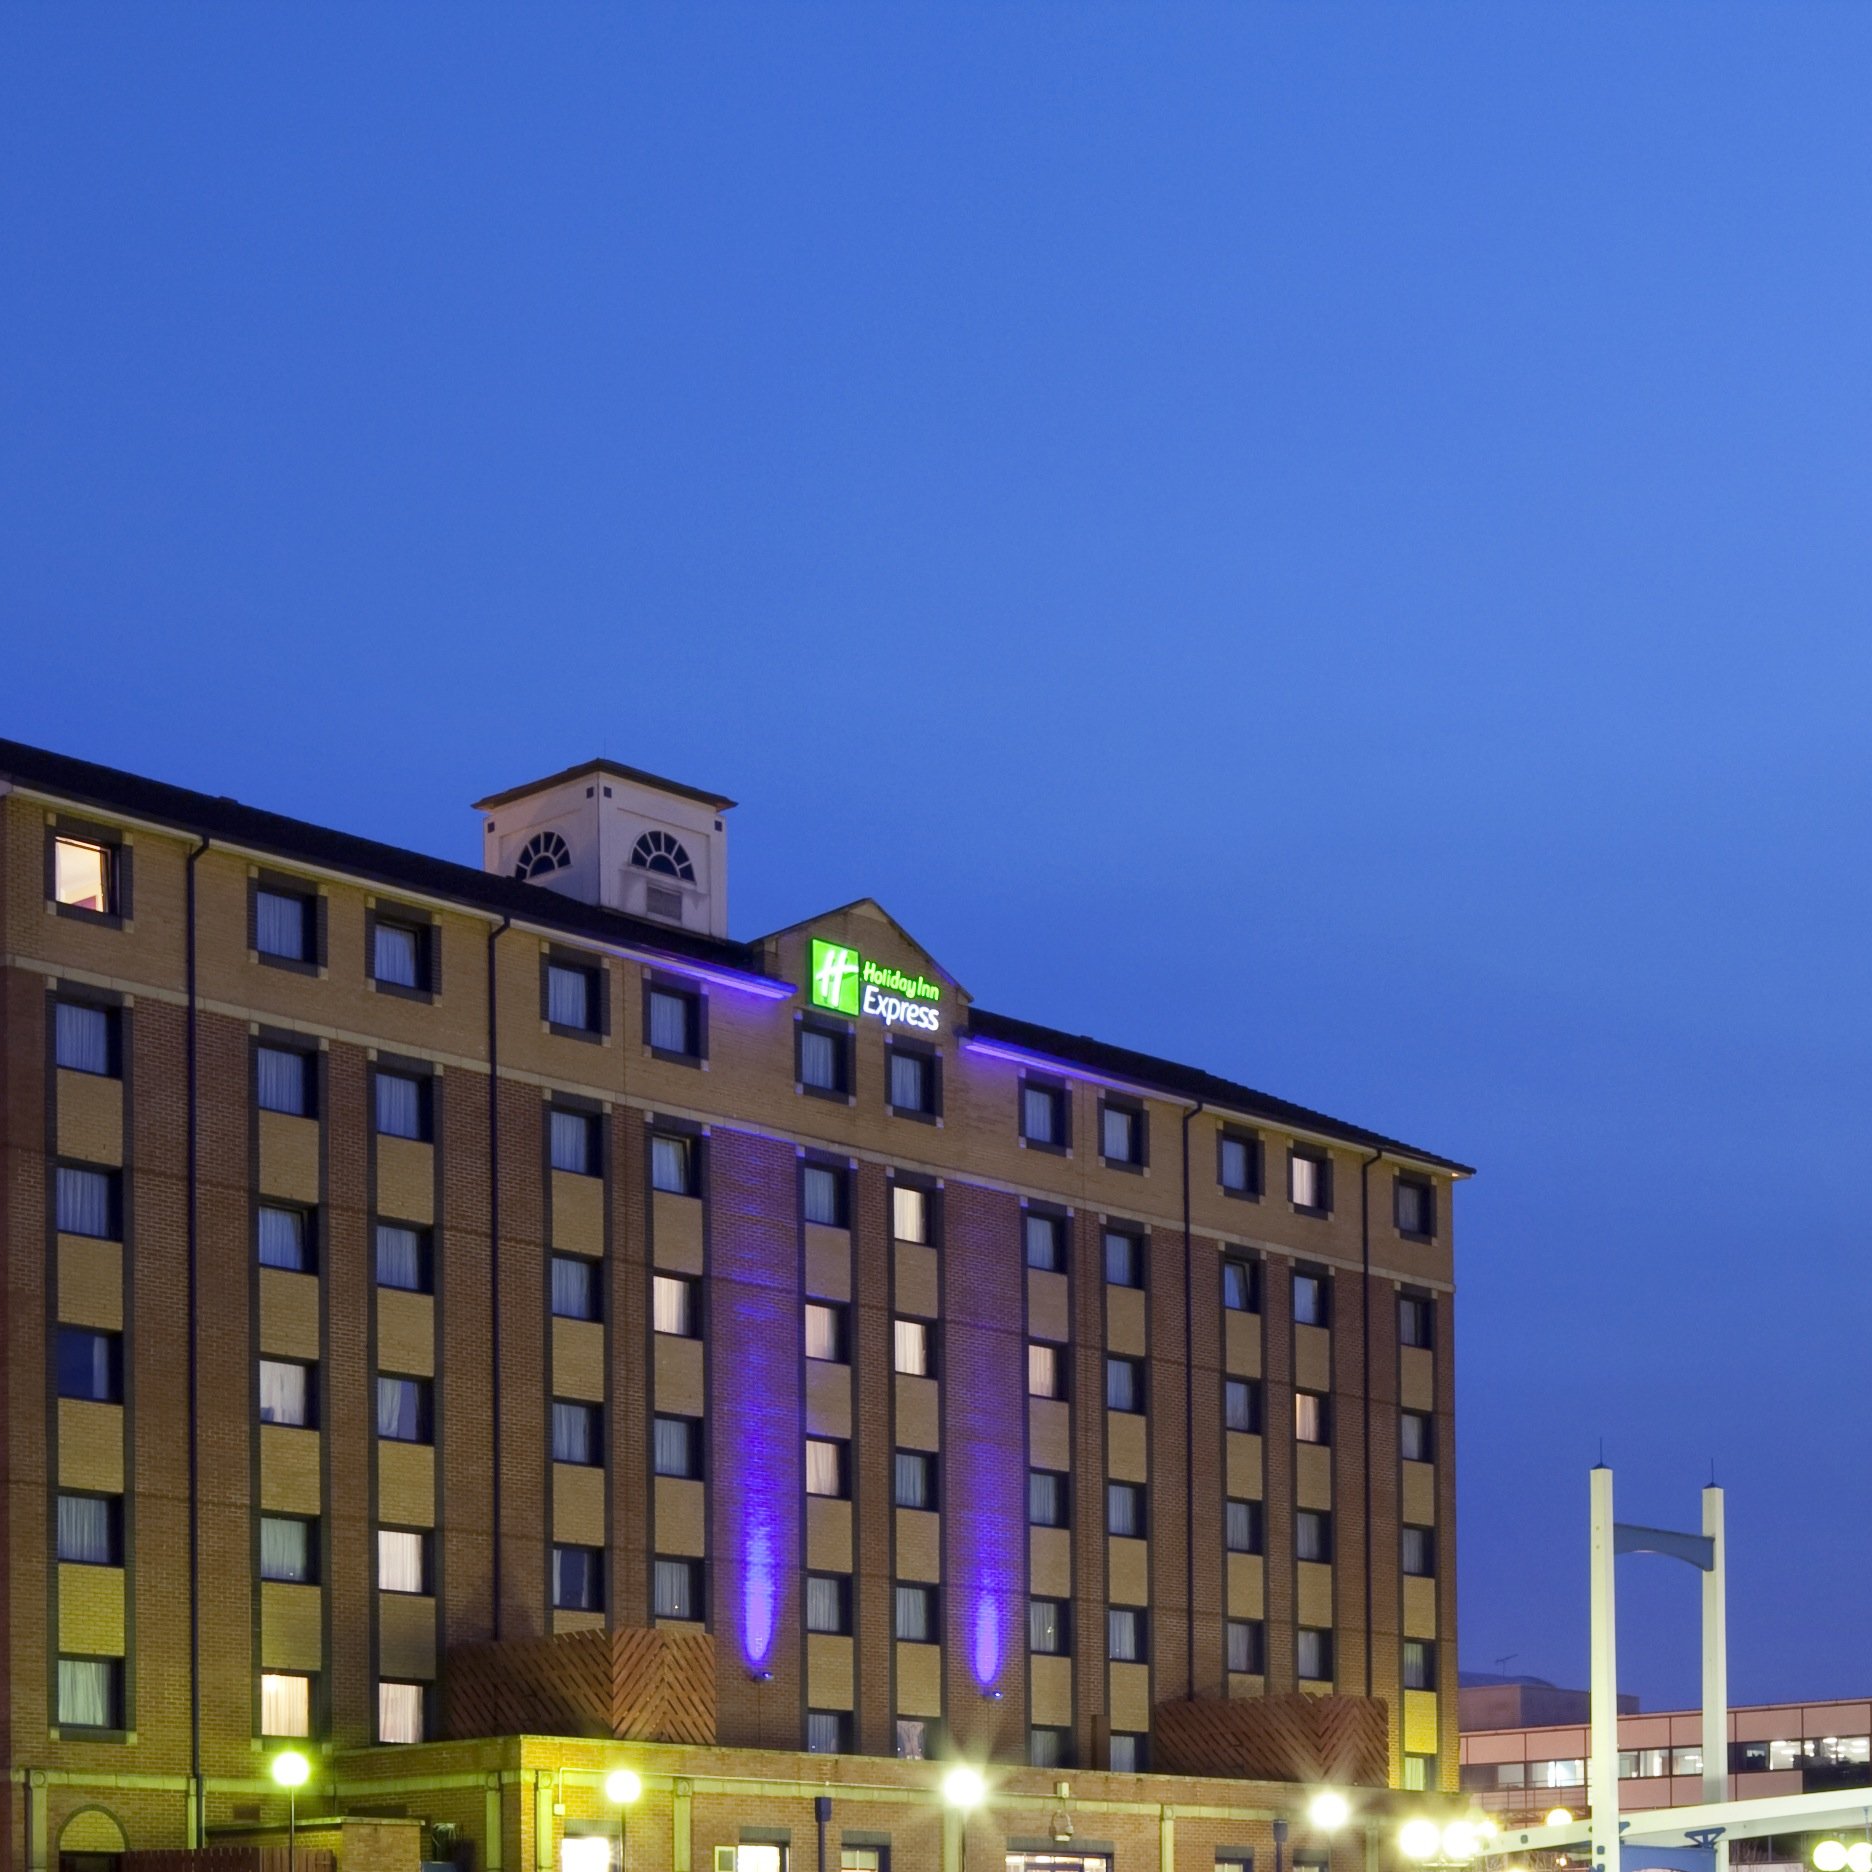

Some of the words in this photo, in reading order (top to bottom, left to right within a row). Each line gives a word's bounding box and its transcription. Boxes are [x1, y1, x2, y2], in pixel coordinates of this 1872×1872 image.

[863, 960, 917, 999] Holiday
[917, 976, 941, 1001] Inn
[863, 985, 941, 1032] Express
